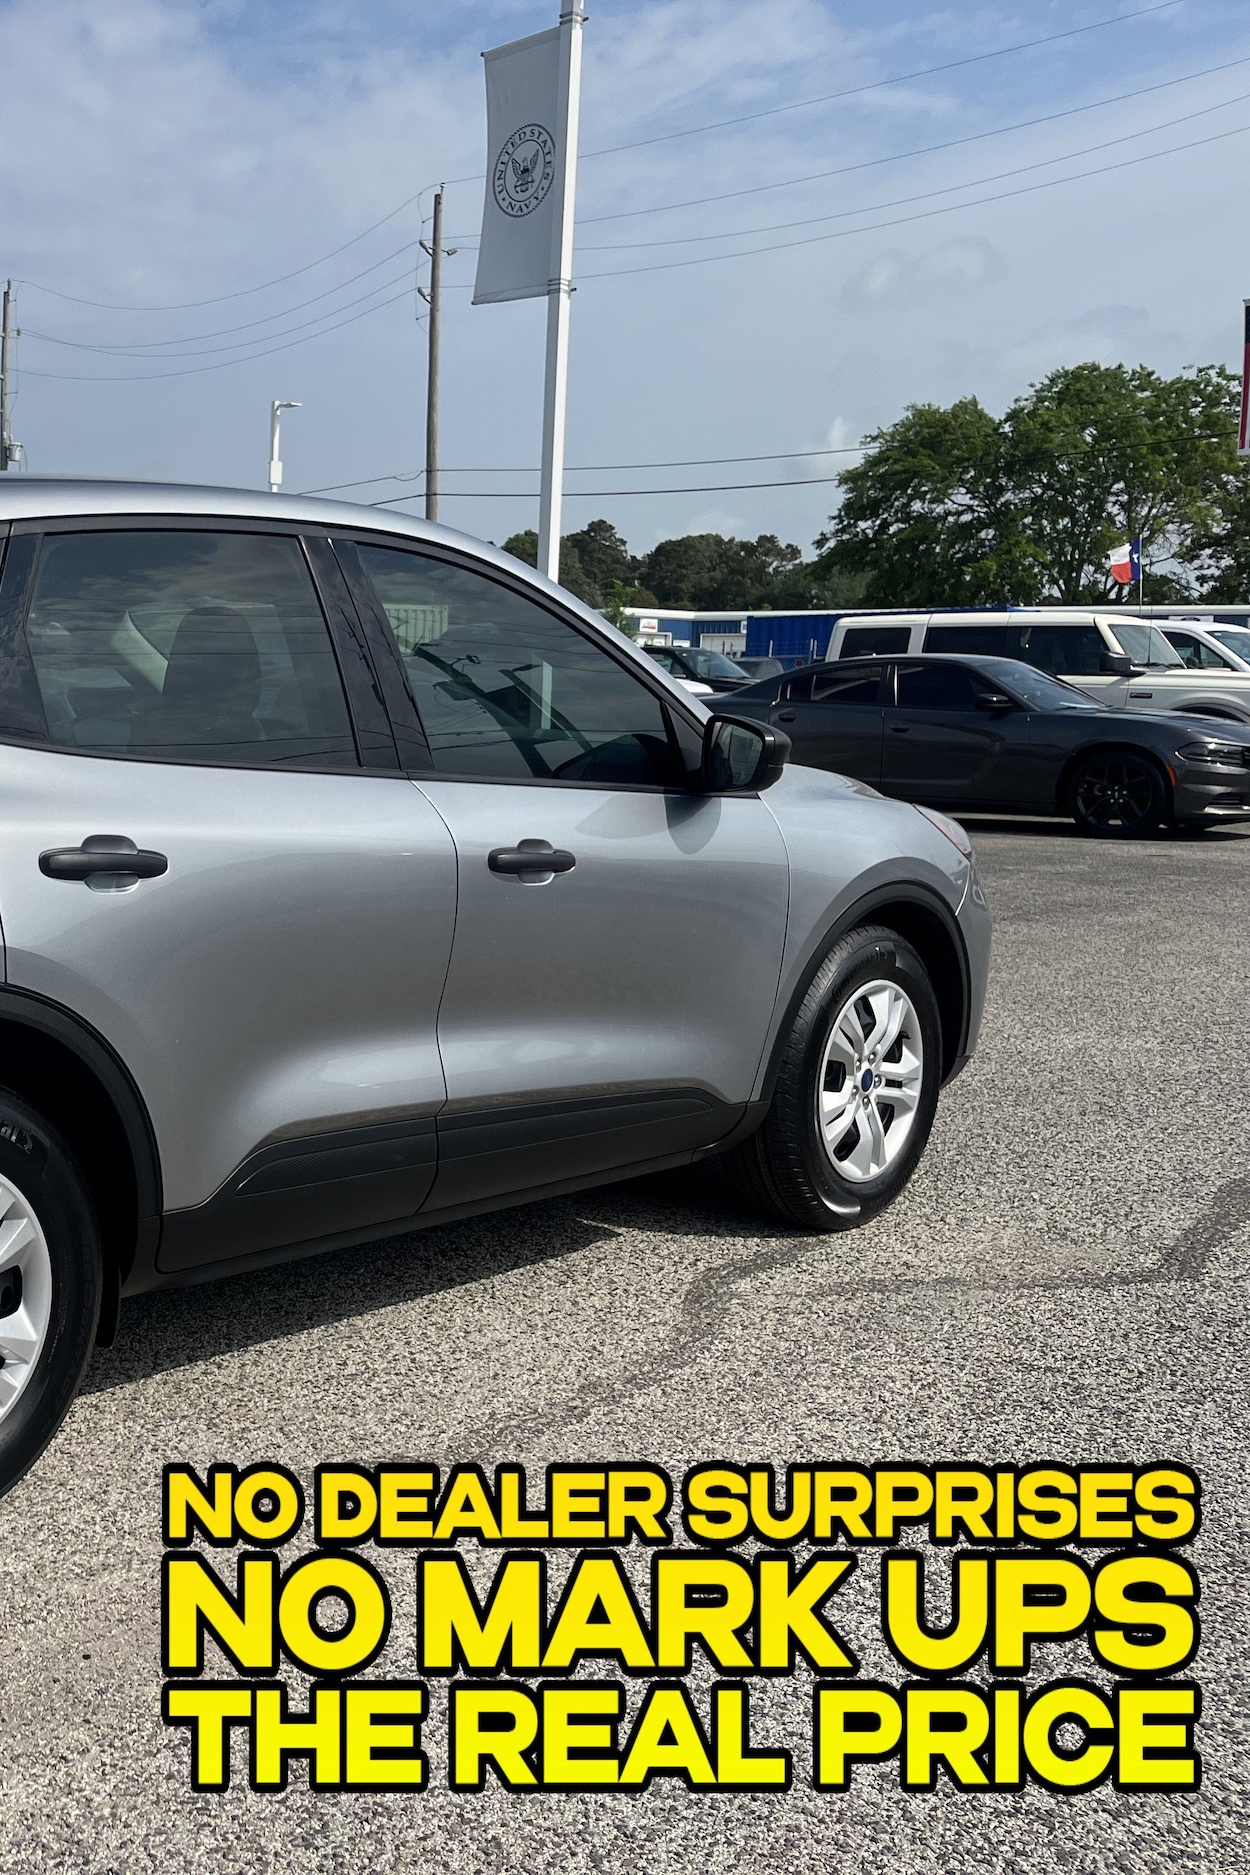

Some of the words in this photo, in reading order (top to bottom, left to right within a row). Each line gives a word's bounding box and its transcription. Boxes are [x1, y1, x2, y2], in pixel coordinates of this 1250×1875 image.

[497, 131, 526, 195] UNITED
[529, 128, 552, 181] STATES
[506, 190, 540, 213] NAVY
